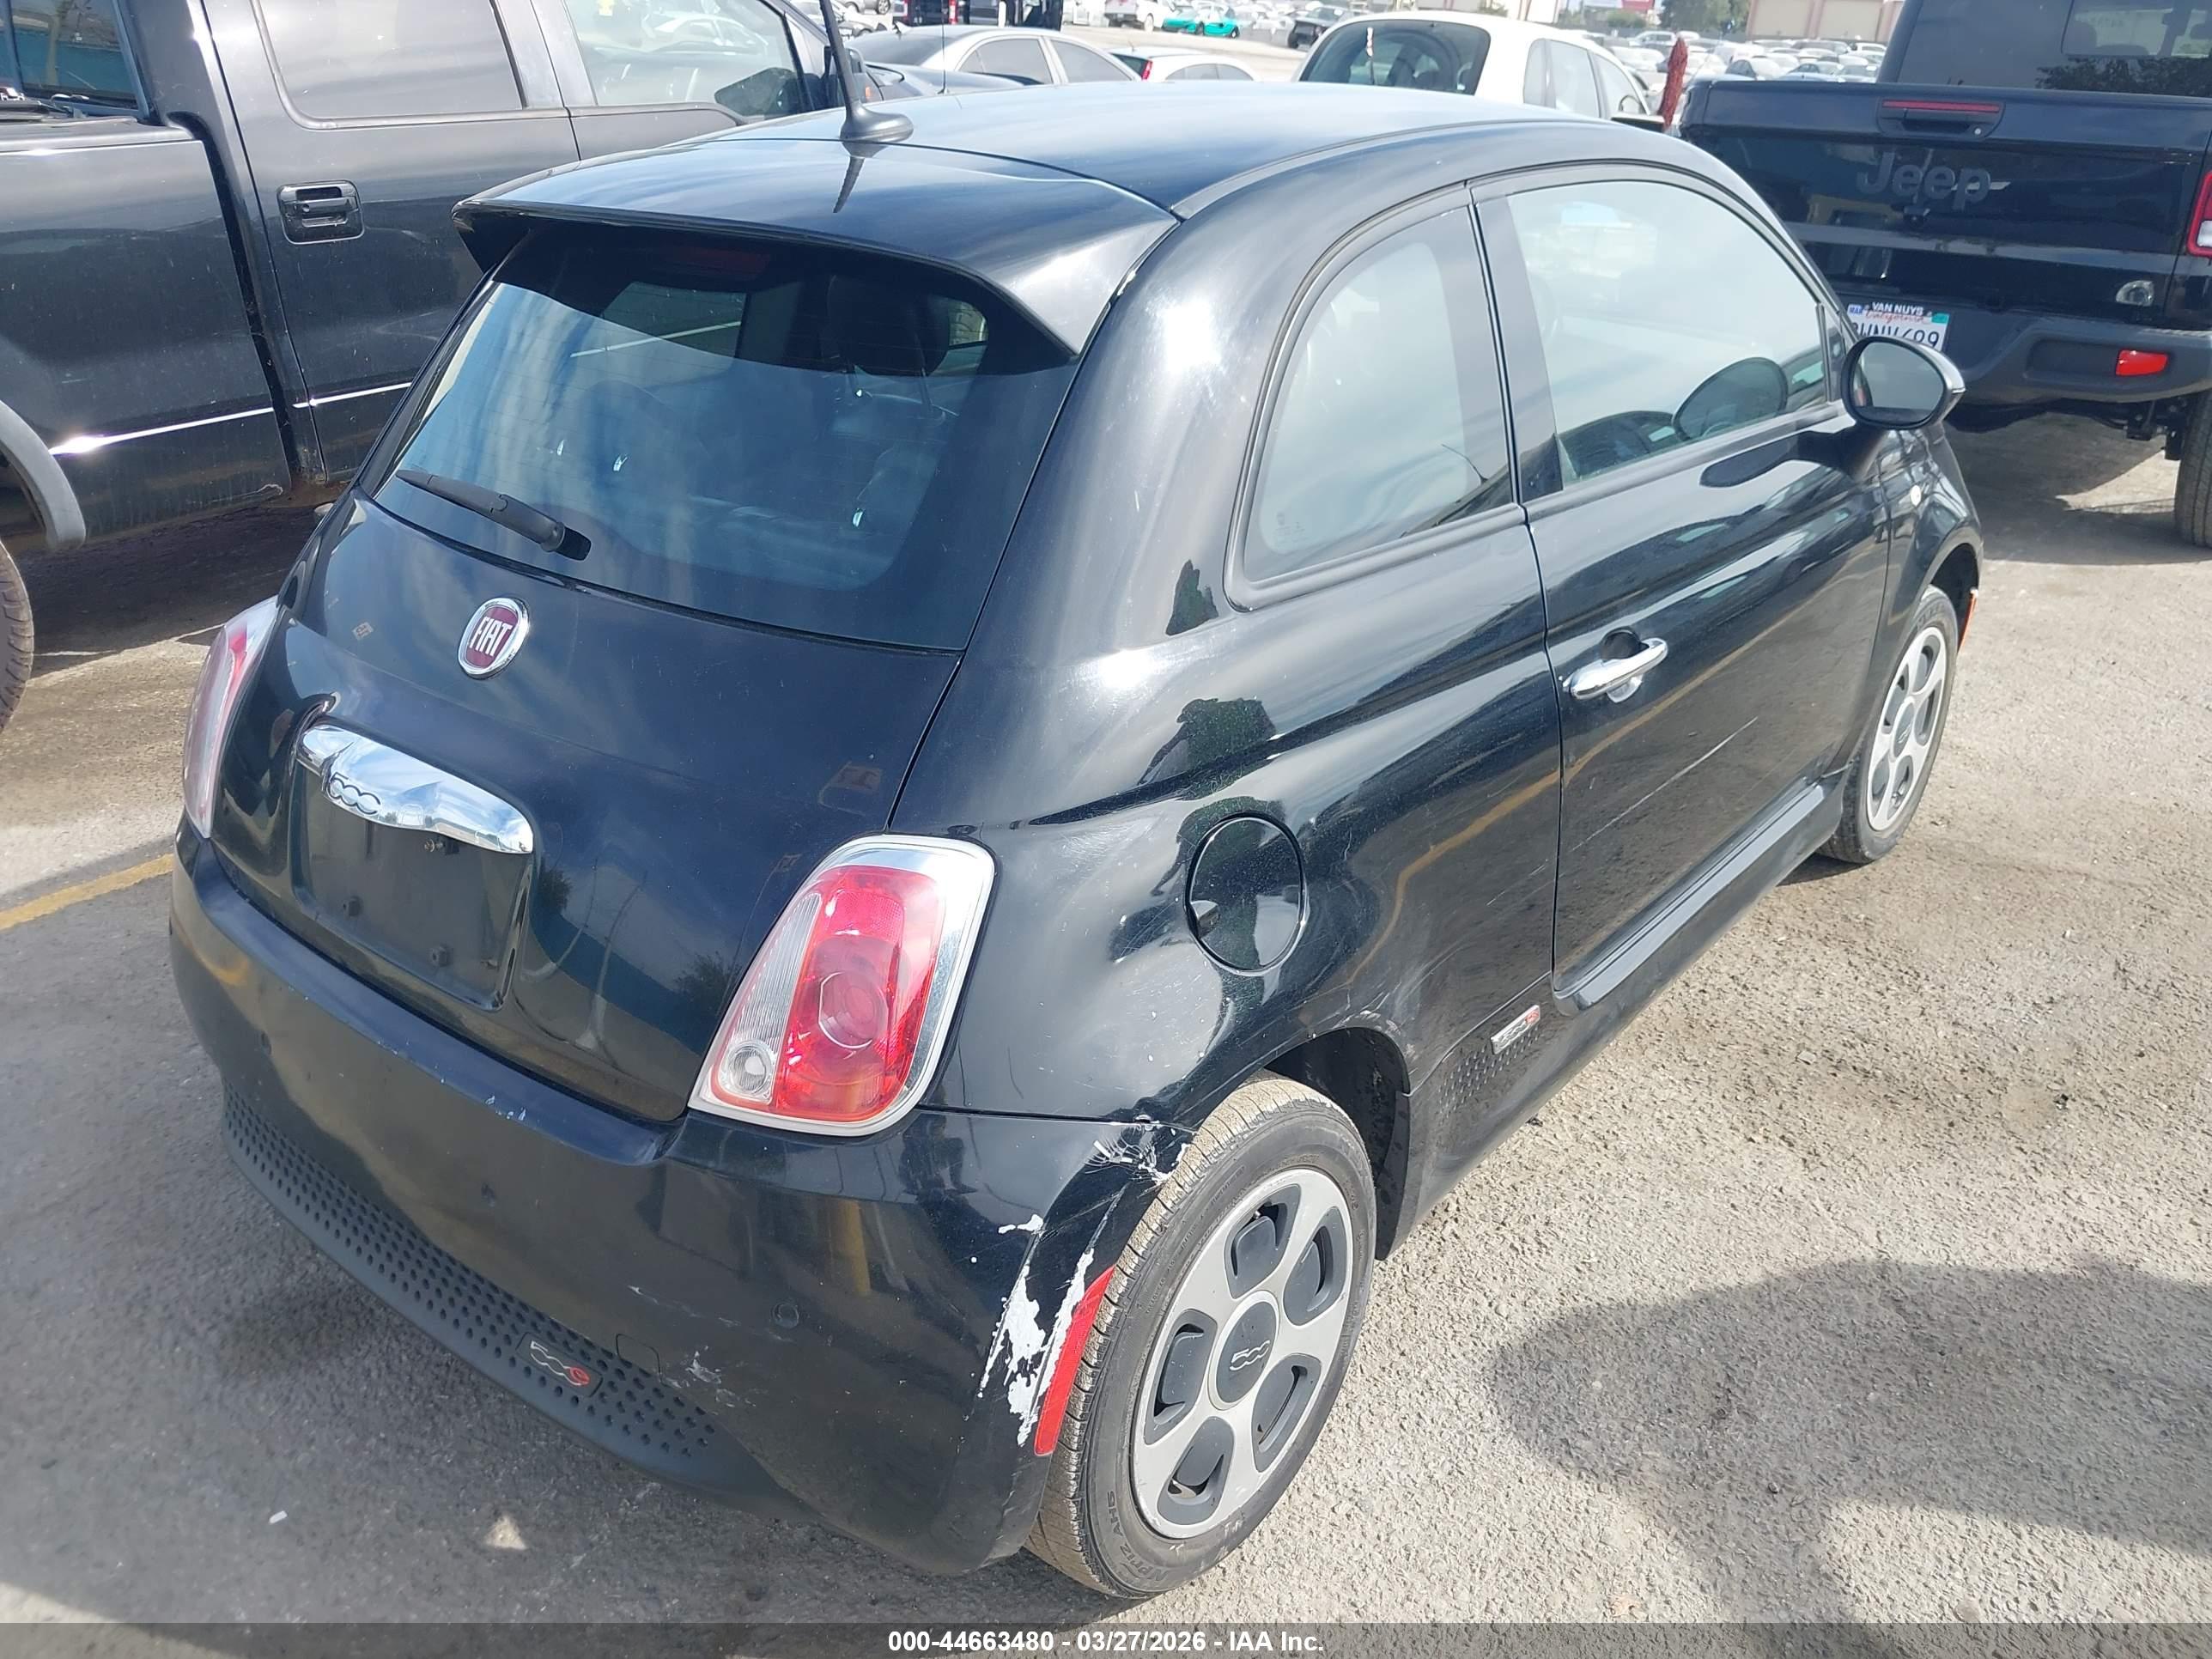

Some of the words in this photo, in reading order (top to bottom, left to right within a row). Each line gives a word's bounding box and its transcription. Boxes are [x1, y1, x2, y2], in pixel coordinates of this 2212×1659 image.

[1856, 151, 1991, 211] Jeep
[1872, 301, 1893, 313] VAN
[1893, 304, 1924, 316] NUYS
[468, 616, 514, 658] FIAT
[1229, 1340, 1271, 1371] 500
